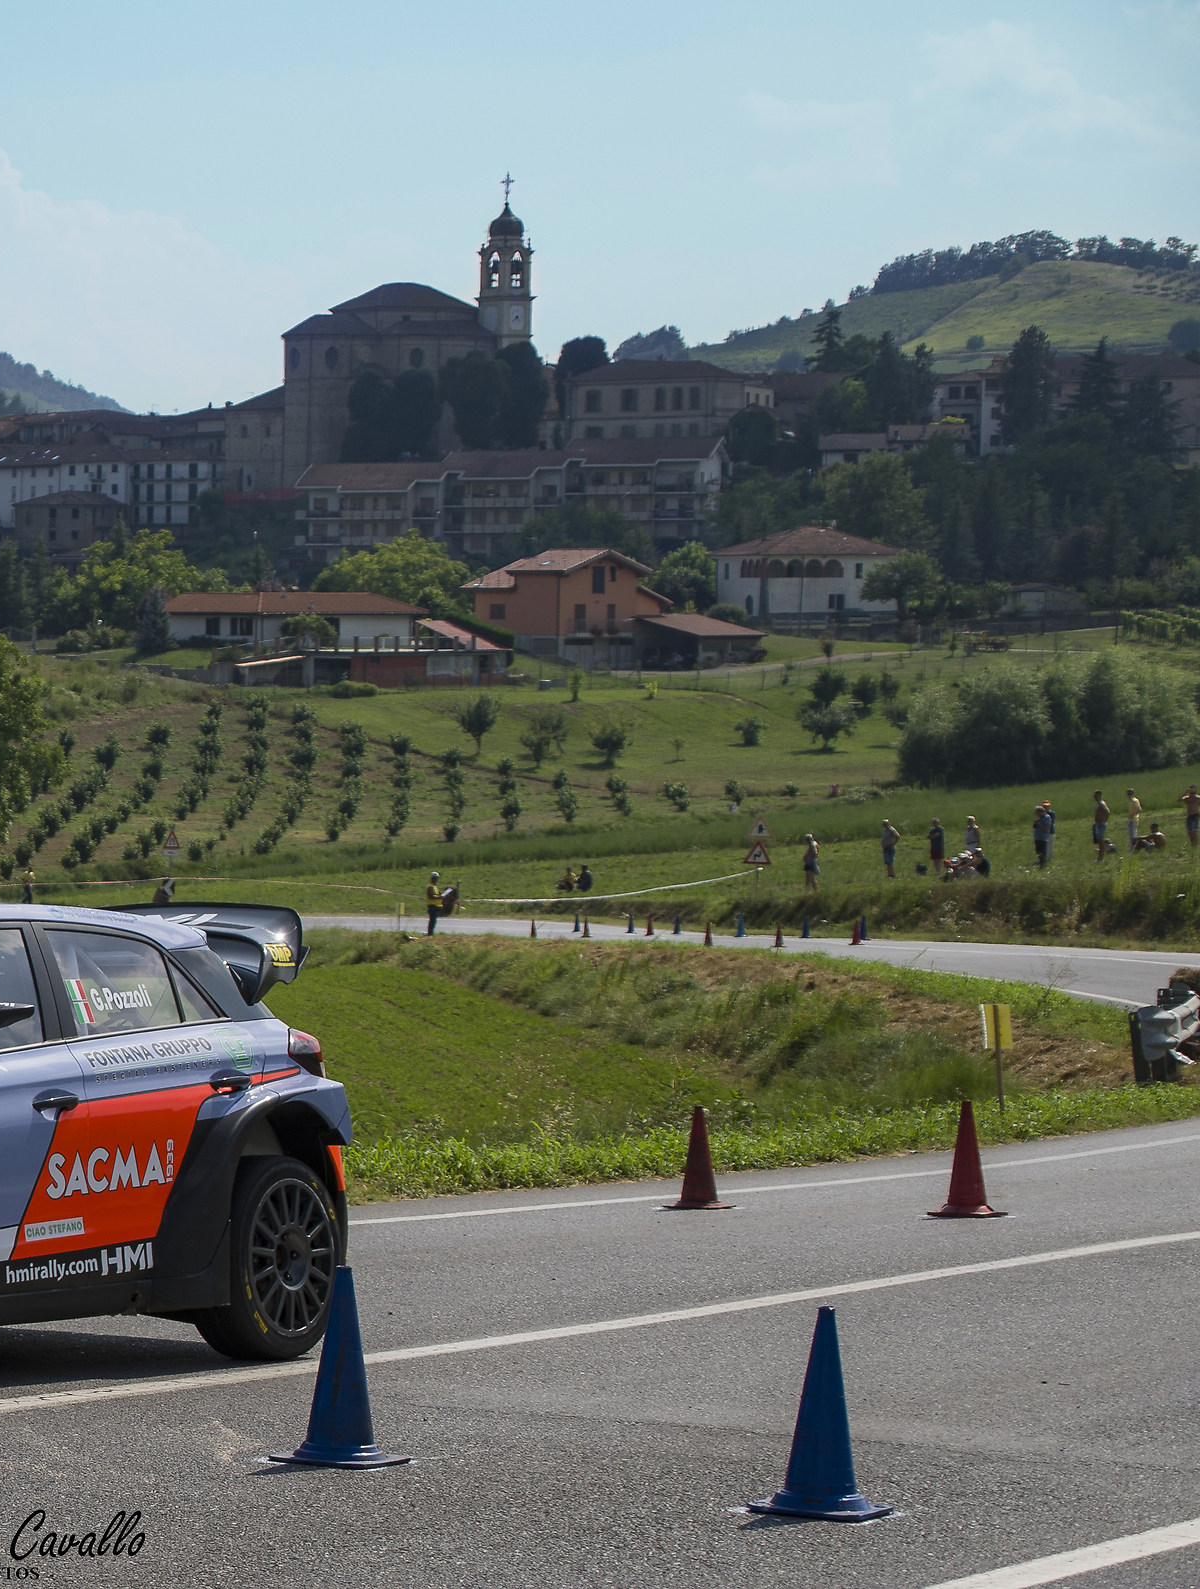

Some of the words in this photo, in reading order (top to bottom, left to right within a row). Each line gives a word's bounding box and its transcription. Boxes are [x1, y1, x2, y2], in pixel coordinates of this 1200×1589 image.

[90, 983, 153, 1011] G.Pozzoli
[83, 1044, 155, 1068] FONTANA
[151, 1036, 213, 1058] GRUPPO
[96, 1068, 148, 1084] SPECIAL
[156, 1058, 221, 1075] FASTENERS
[46, 1140, 166, 1200] SACMA
[166, 1139, 174, 1183] 1939
[26, 1226, 46, 1238] CIAO
[48, 1221, 83, 1235] STEFANO
[5, 1257, 99, 1284] hmirally.com
[100, 1242, 154, 1276] HMI
